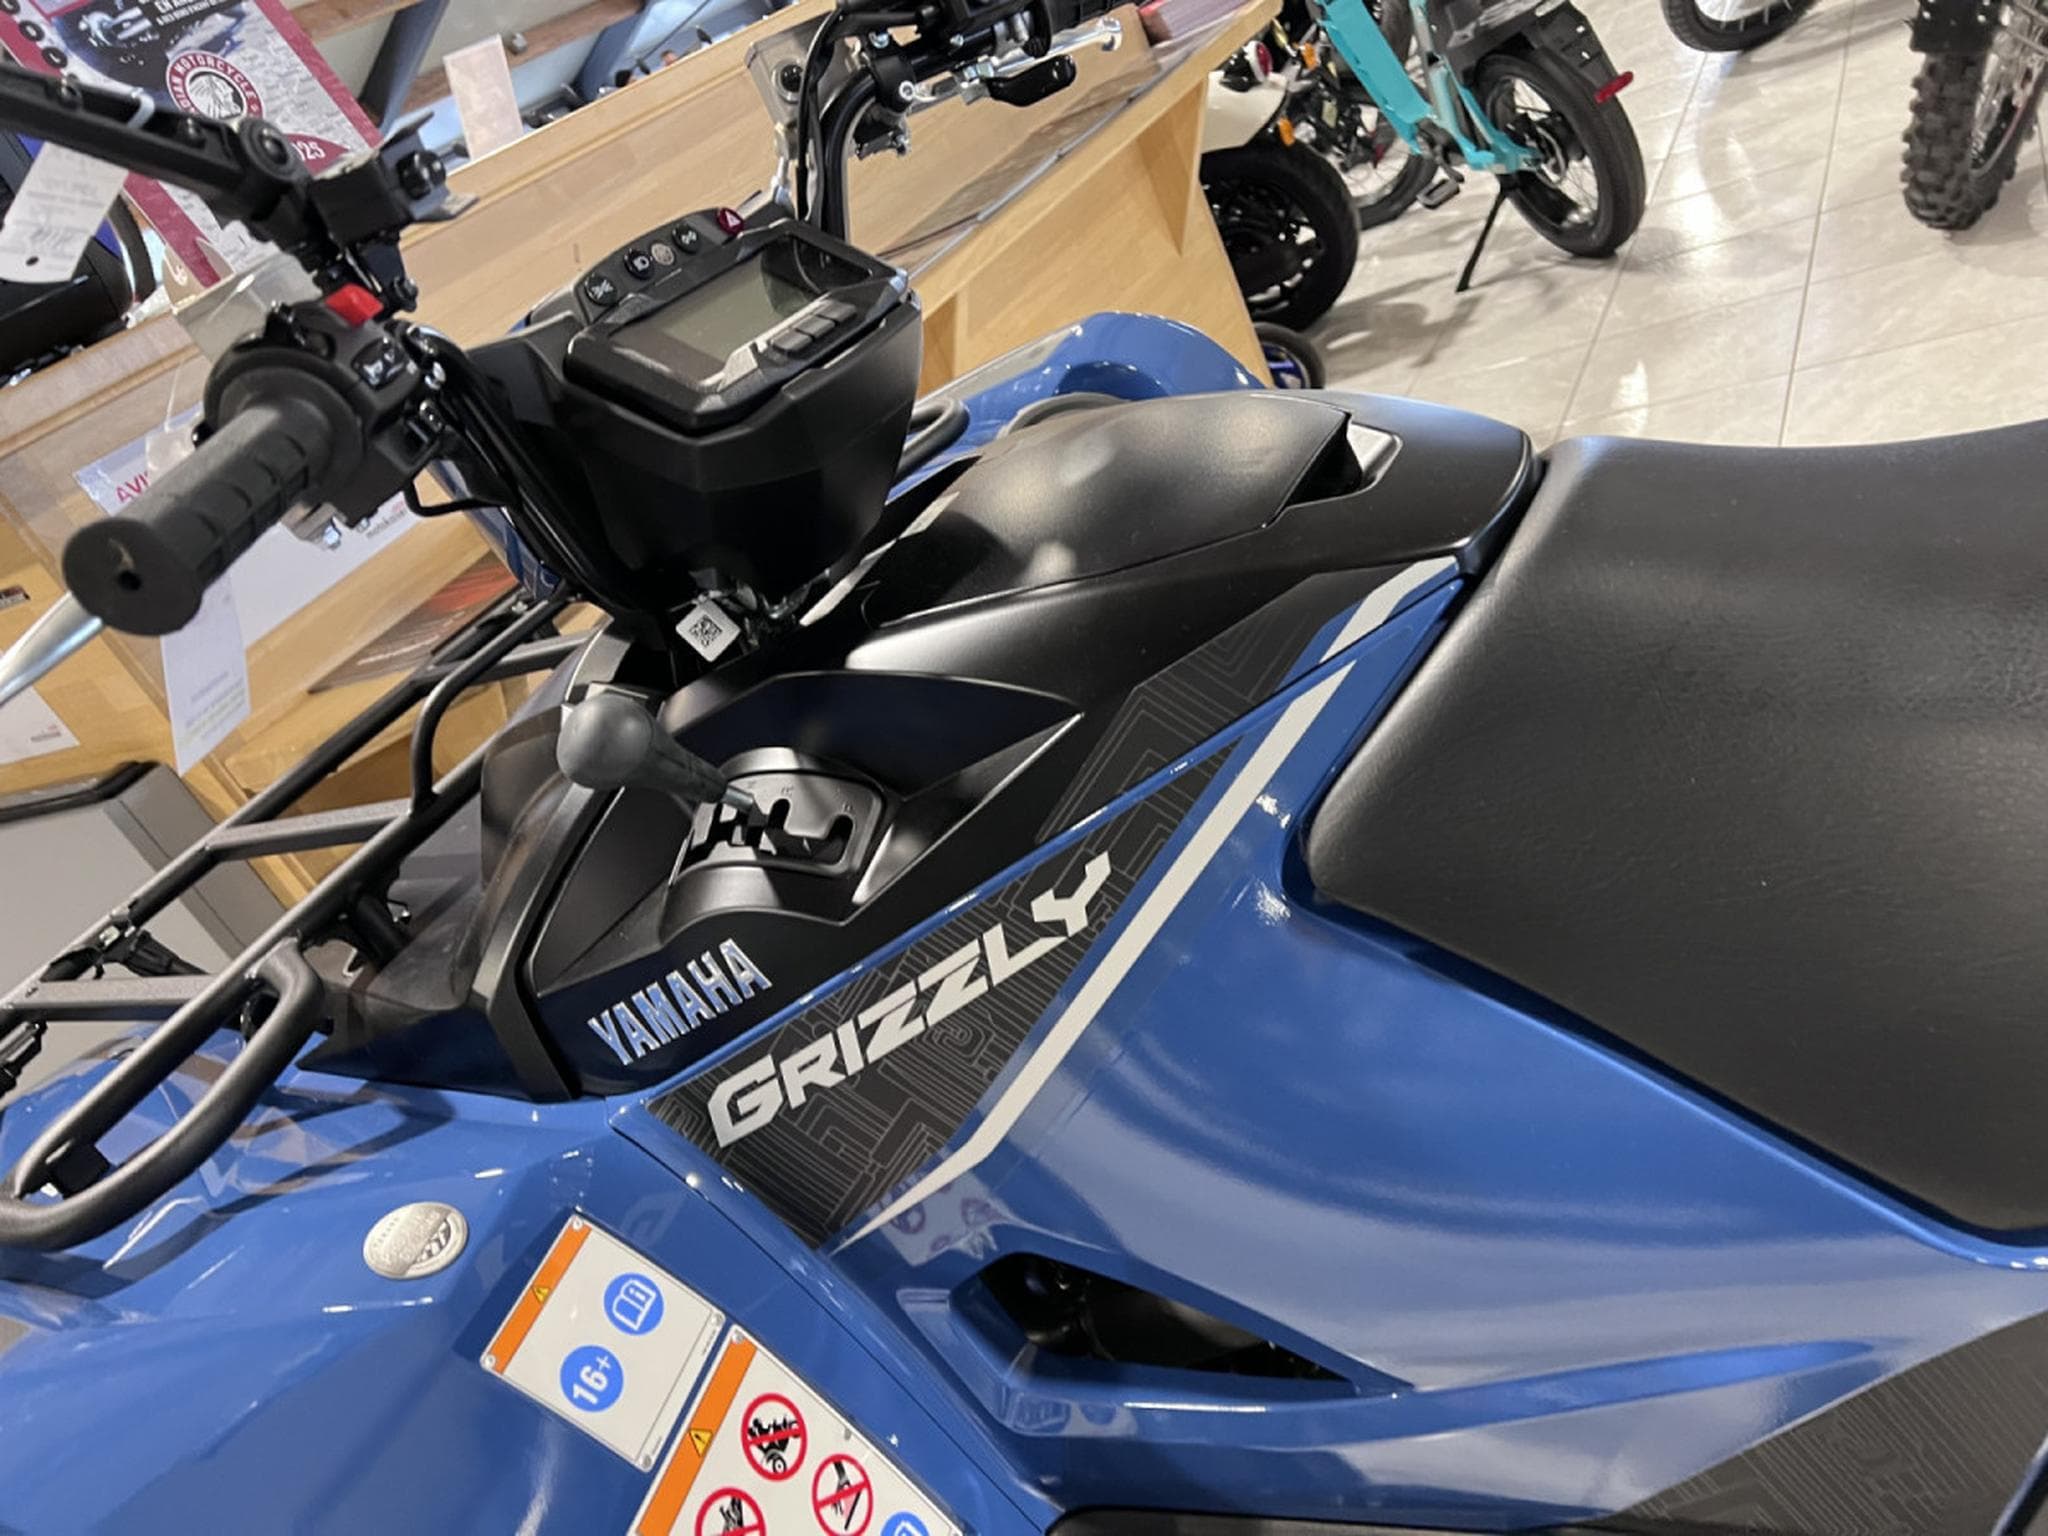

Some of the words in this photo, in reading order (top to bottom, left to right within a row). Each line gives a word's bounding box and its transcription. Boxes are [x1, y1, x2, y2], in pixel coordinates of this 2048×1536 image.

[173, 53, 258, 99] MOTORCYCLE
[116, 470, 148, 502] AVI
[587, 938, 772, 1066] YAMAHA
[708, 851, 1112, 1147] GRIZZLY
[573, 1356, 611, 1404] 16+
